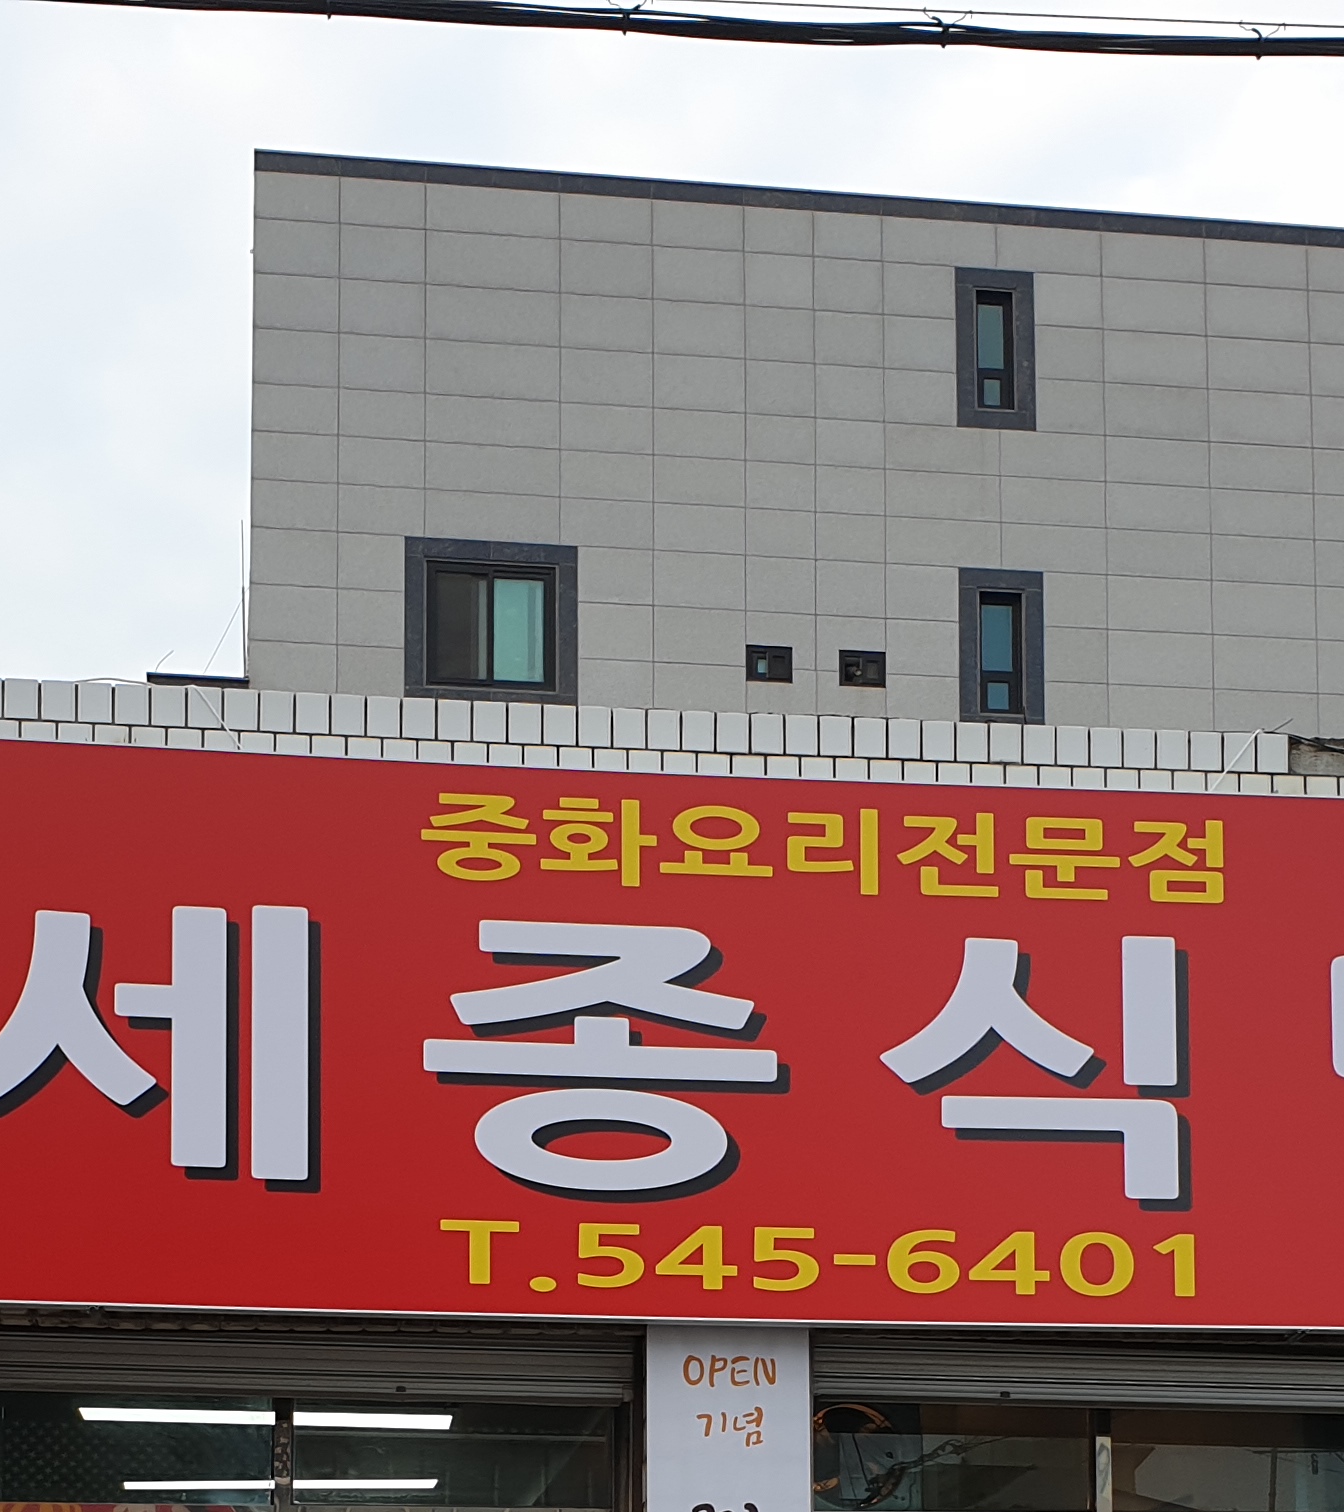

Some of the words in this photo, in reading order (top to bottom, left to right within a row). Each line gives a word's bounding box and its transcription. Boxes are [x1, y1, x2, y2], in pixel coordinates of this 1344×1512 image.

[421, 792, 1226, 904] 중화요리전문점
[440, 1219, 1197, 1298] T.545-6401
[683, 1355, 778, 1388] OPEN
[696, 1406, 764, 1447] 기념
